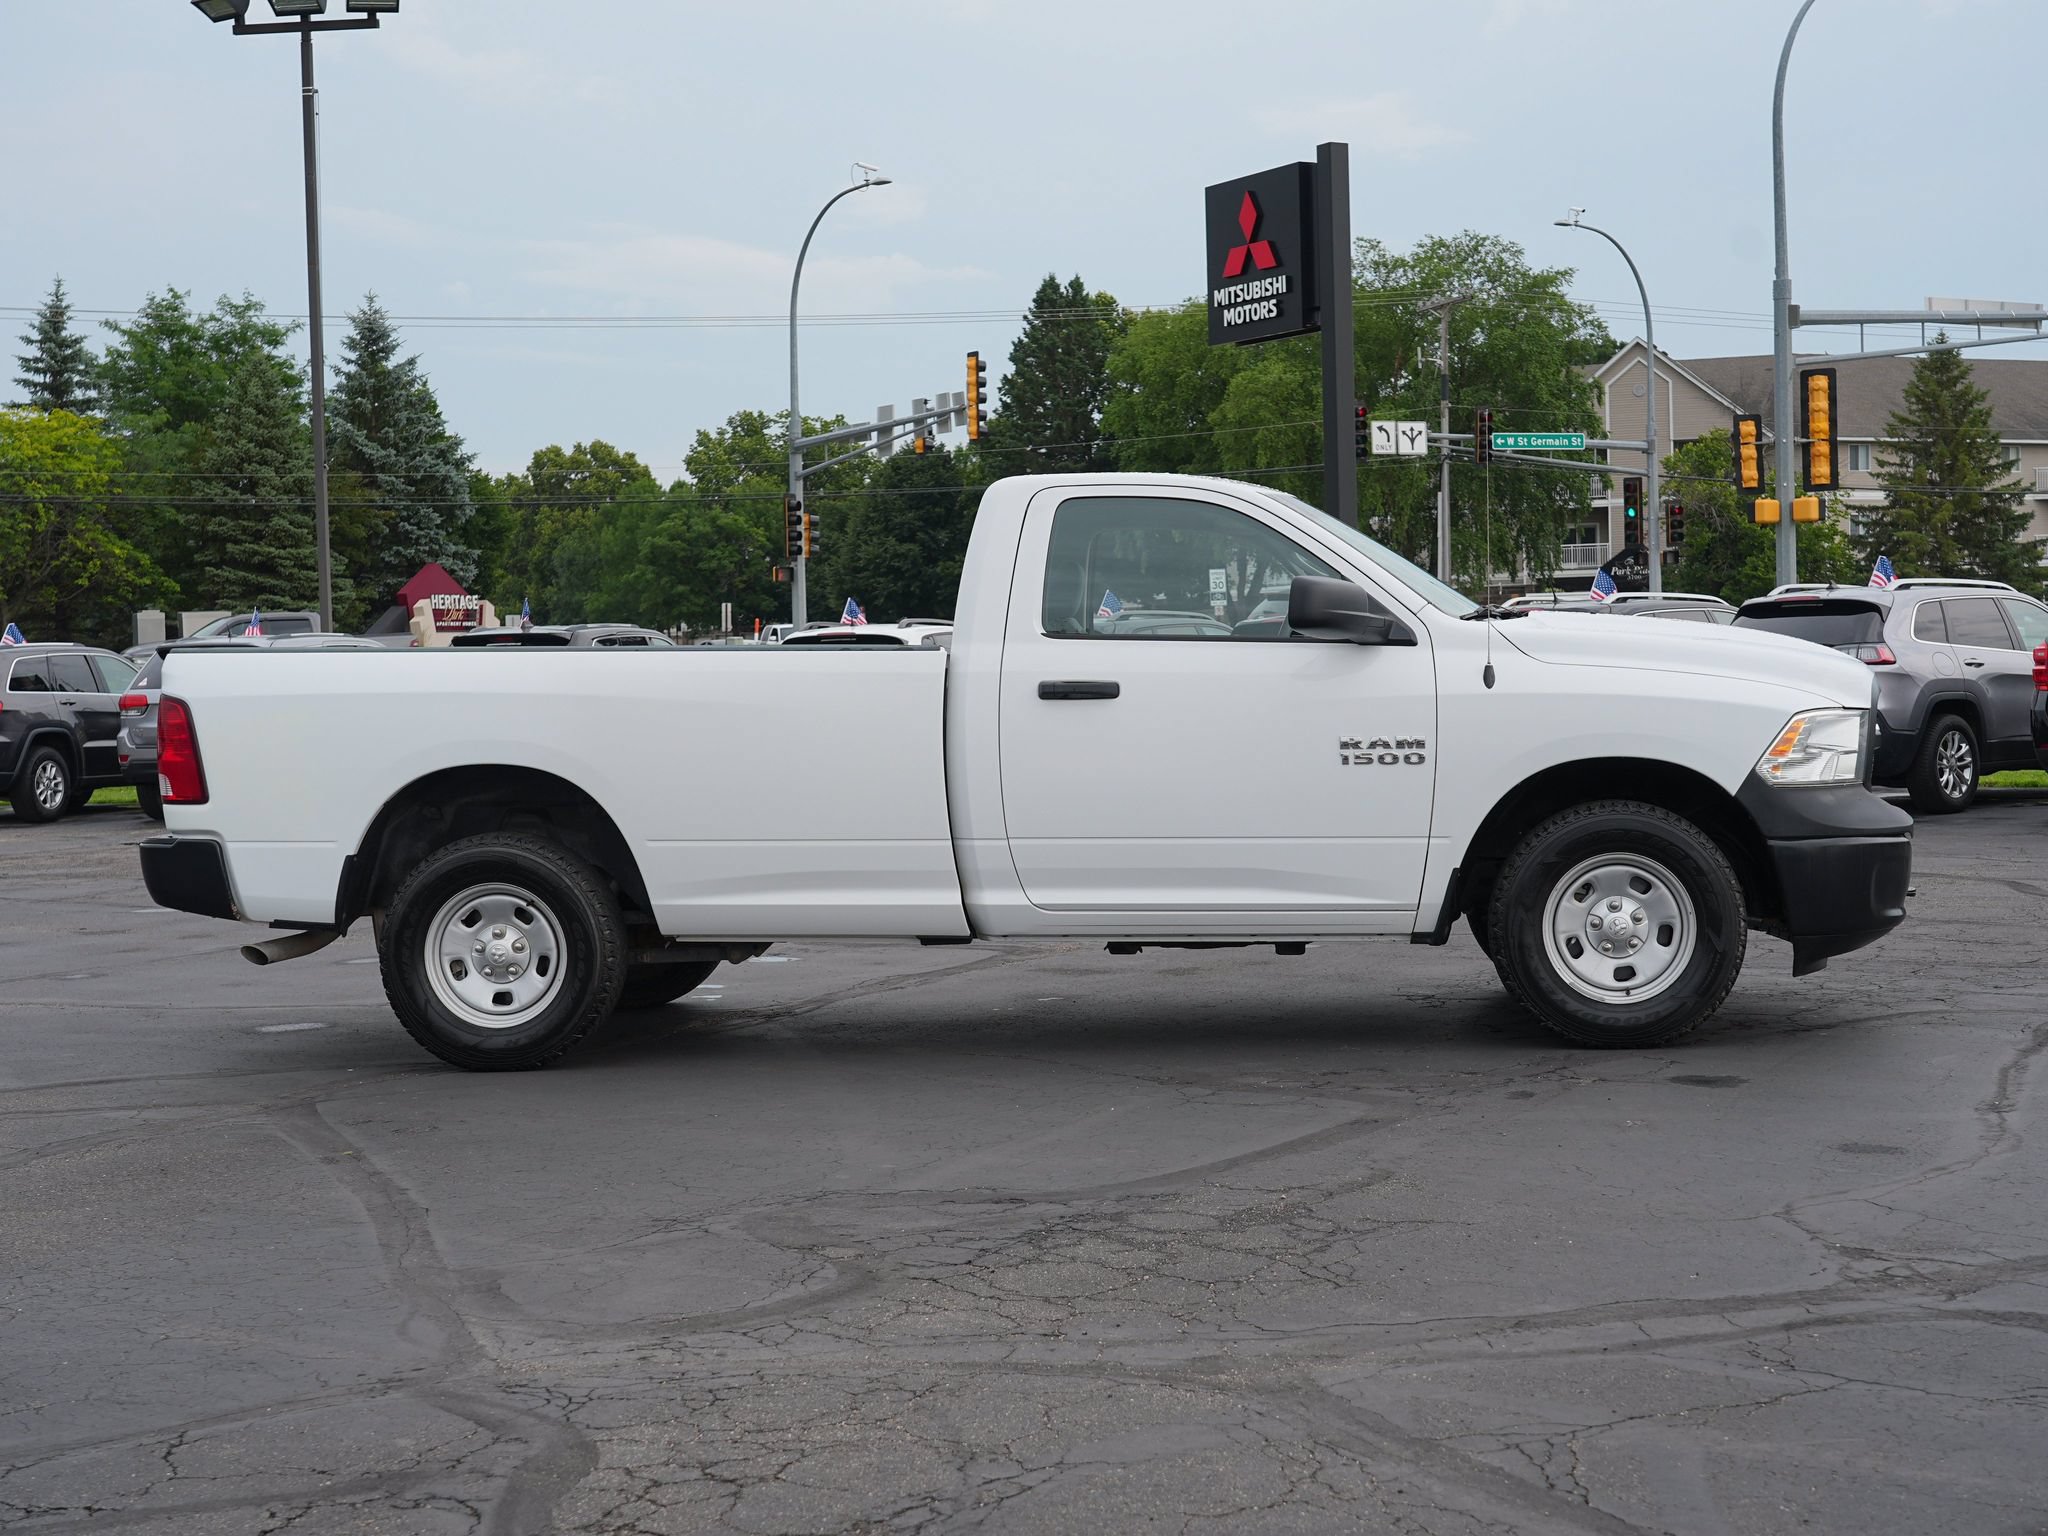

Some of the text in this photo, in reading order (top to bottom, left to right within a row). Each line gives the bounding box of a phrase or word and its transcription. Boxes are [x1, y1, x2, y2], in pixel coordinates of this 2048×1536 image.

[1213, 275, 1287, 307] MITSUBISHI
[1223, 299, 1278, 327] MOTORS
[1375, 443, 1393, 451] ONLY
[1506, 436, 1582, 446] W St Germain St
[1610, 566, 1631, 576] Park
[1212, 581, 1225, 590] 30
[431, 594, 479, 610] HERITAGE
[1339, 736, 1426, 750] RAM
[1340, 751, 1426, 766] 1500
